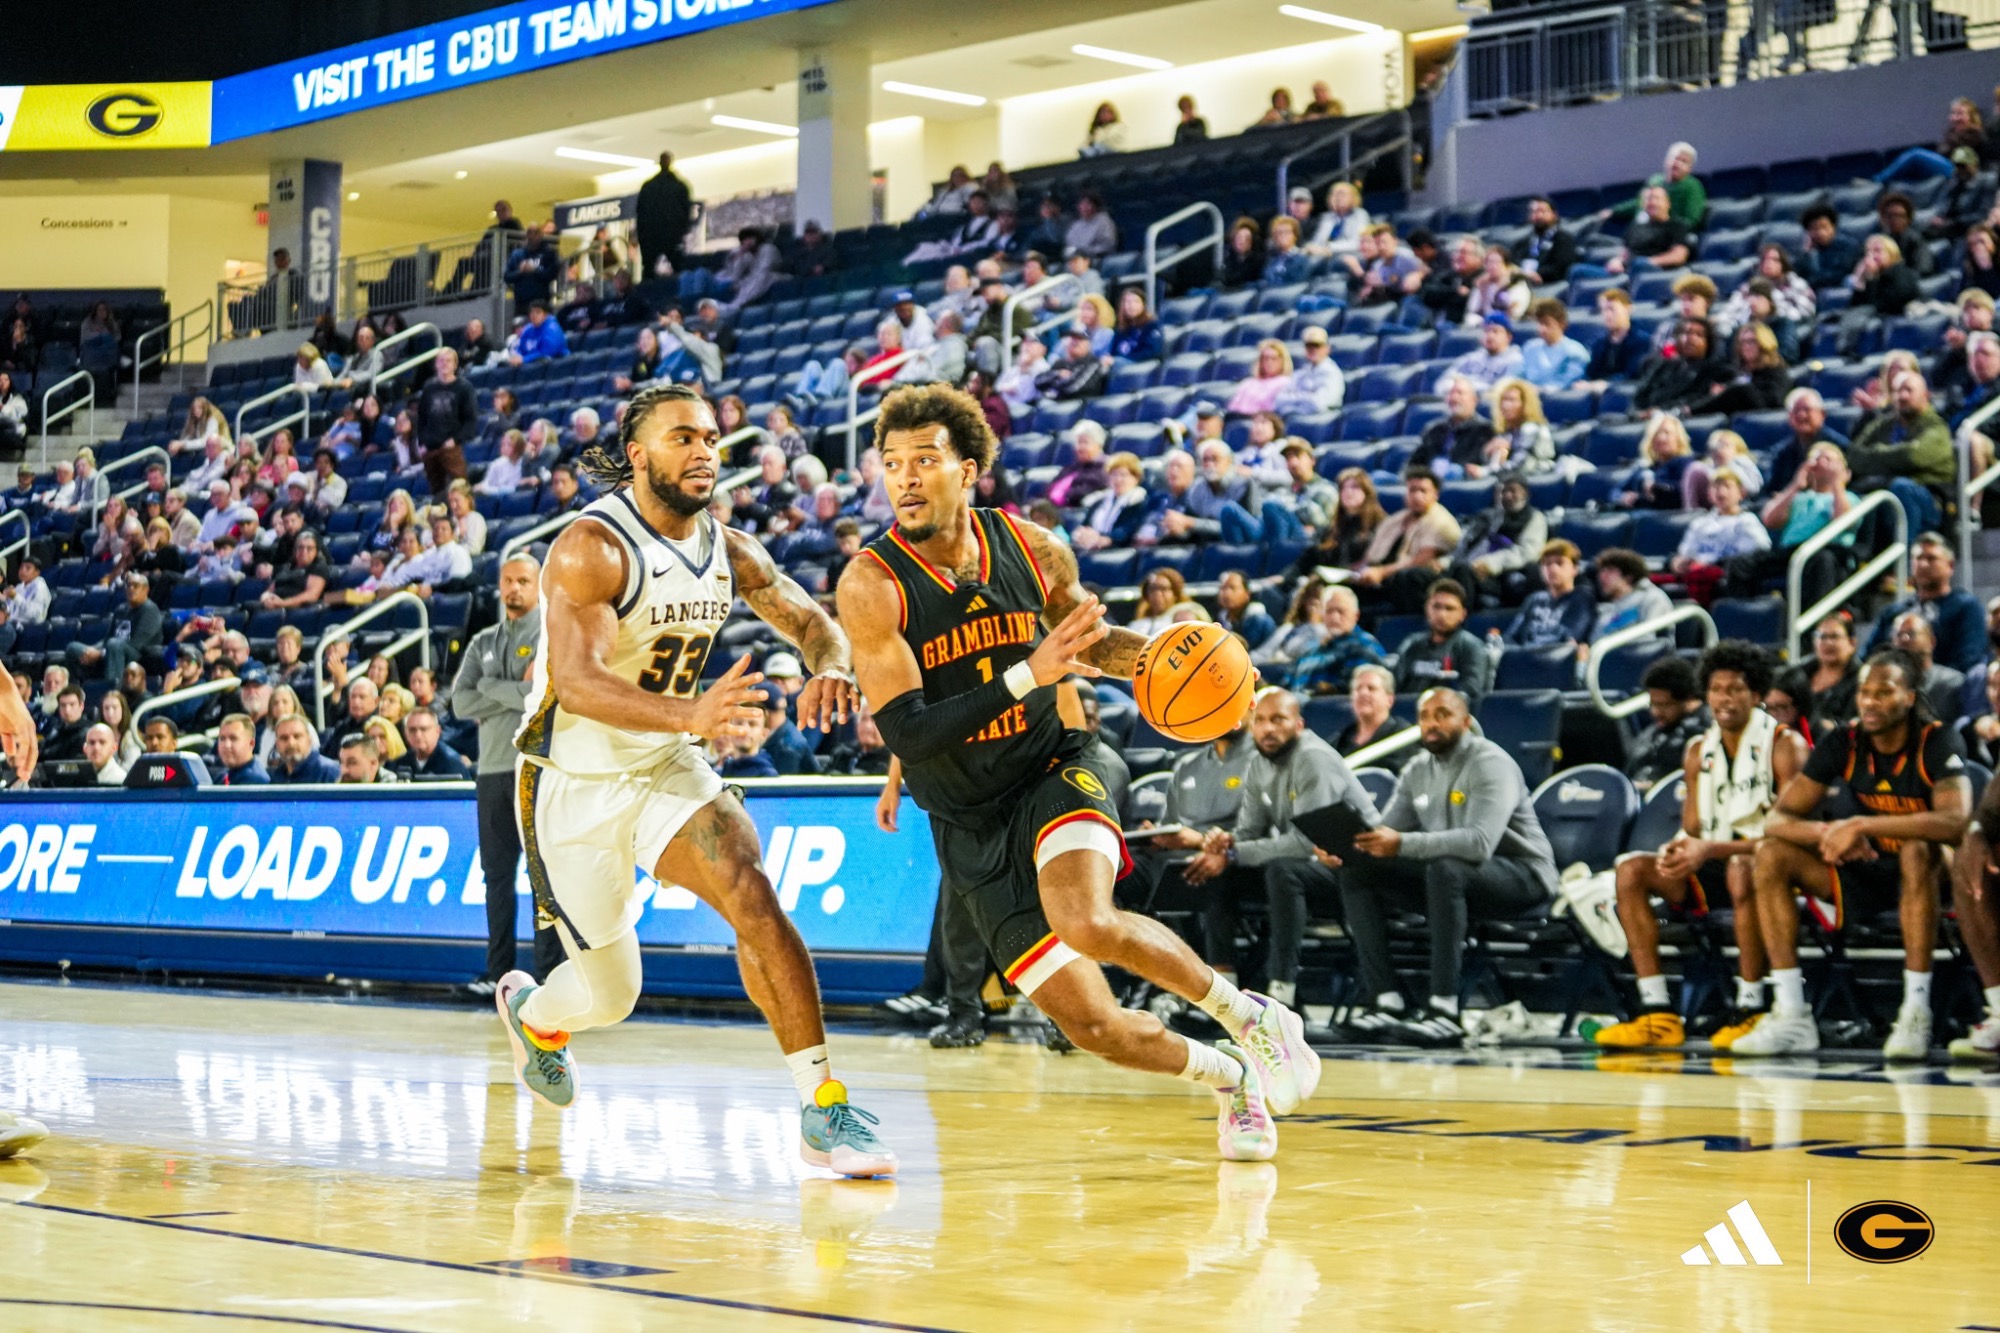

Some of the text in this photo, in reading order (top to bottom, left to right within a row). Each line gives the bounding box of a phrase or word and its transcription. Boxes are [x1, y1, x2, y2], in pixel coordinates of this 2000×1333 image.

[293, 56, 369, 112] VISIT
[373, 39, 435, 93] THE
[448, 17, 521, 77] CBU
[528, 0, 627, 56] TEAM
[41, 217, 114, 229] Concessions
[568, 200, 621, 226] LANCERS
[309, 206, 331, 303] CBU
[650, 601, 729, 626] LANCERS
[922, 611, 1036, 670] GRAMBLING
[1168, 630, 1203, 670] EVO
[637, 633, 712, 697] 33
[976, 656, 994, 684] 1
[148, 765, 166, 782] POSS
[0, 823, 97, 893] ORE
[175, 824, 344, 900] LOAD
[350, 825, 450, 906] UP.
